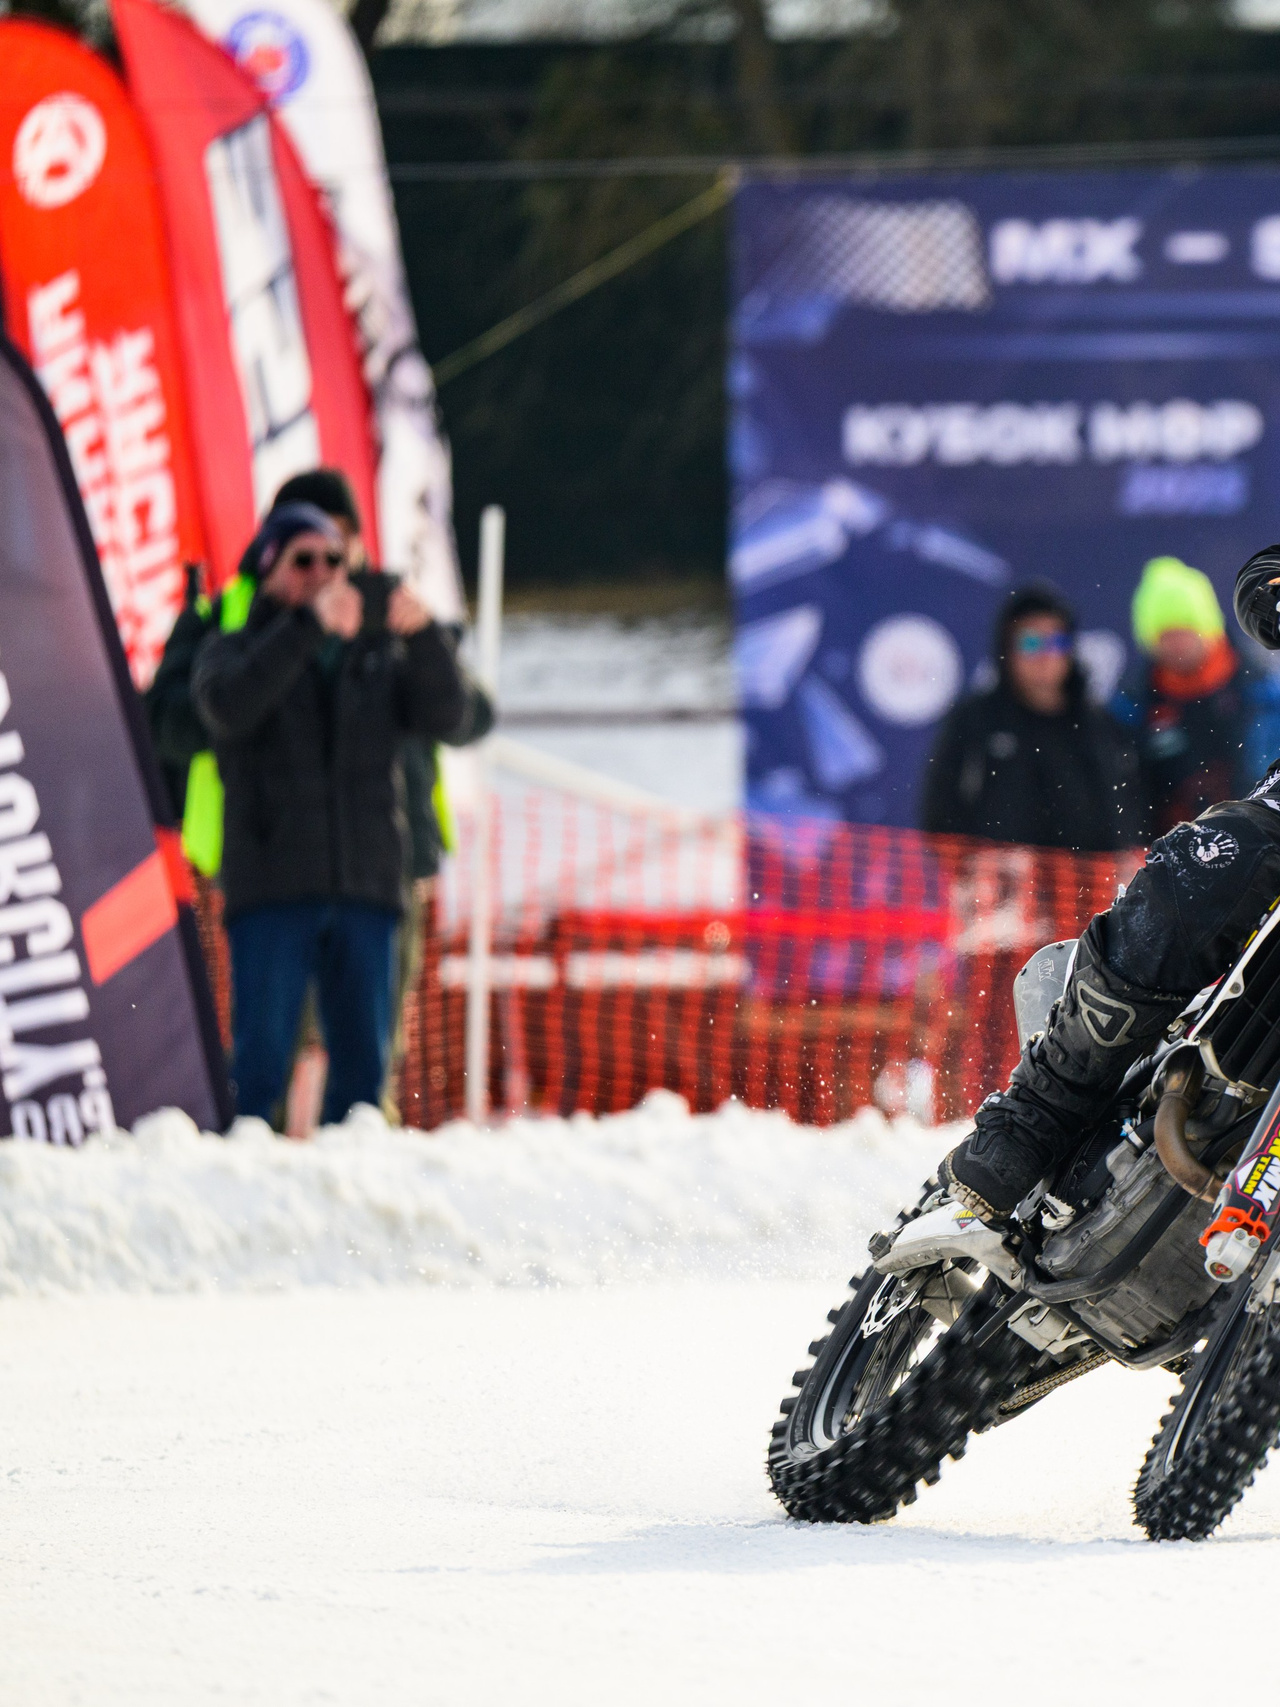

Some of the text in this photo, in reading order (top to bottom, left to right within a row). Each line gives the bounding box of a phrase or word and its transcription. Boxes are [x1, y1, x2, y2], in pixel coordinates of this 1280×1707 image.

[990, 217, 1143, 282] MX
[1188, 840, 1233, 870] COMPOSITES
[1243, 1155, 1272, 1195] TEAM
